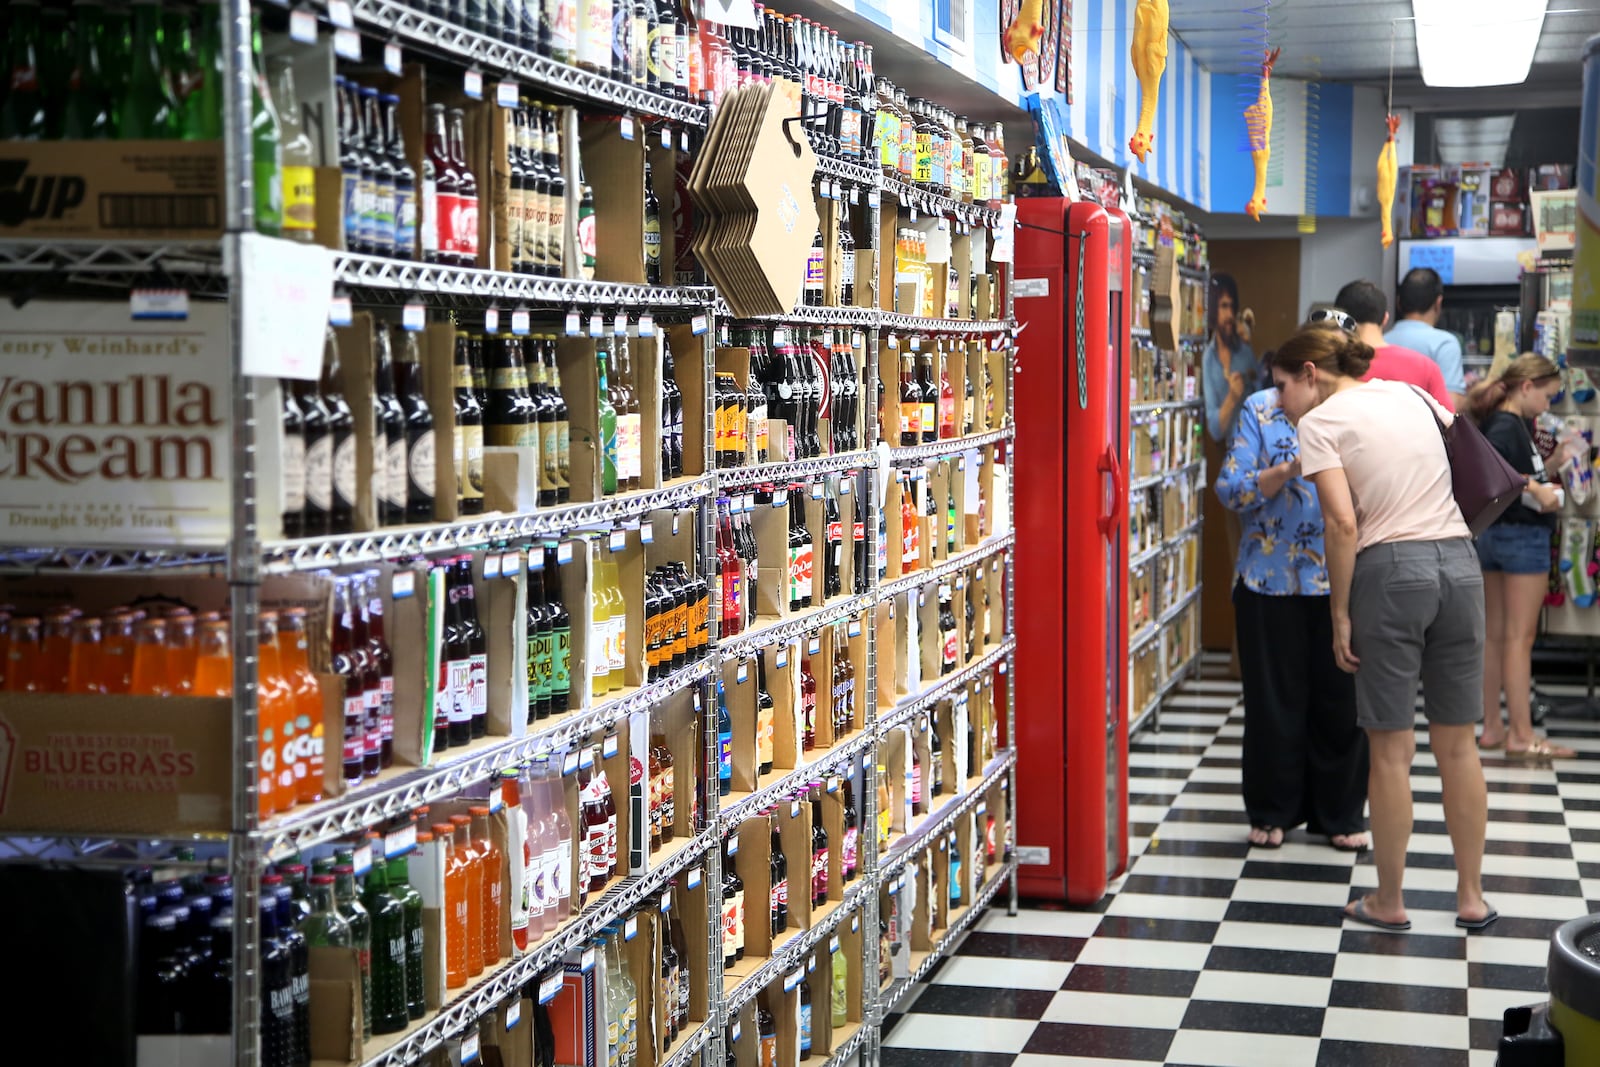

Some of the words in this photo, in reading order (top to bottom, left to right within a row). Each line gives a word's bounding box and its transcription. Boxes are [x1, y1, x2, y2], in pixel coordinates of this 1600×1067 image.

[0, 338, 53, 358] enry
[63, 337, 200, 356] Weinhard's
[9, 512, 77, 529] Draught
[84, 512, 124, 529] Style
[24, 751, 195, 777] BLUEGRASS
[64, 780, 118, 793] GREEN
[124, 780, 176, 793] GLASS
